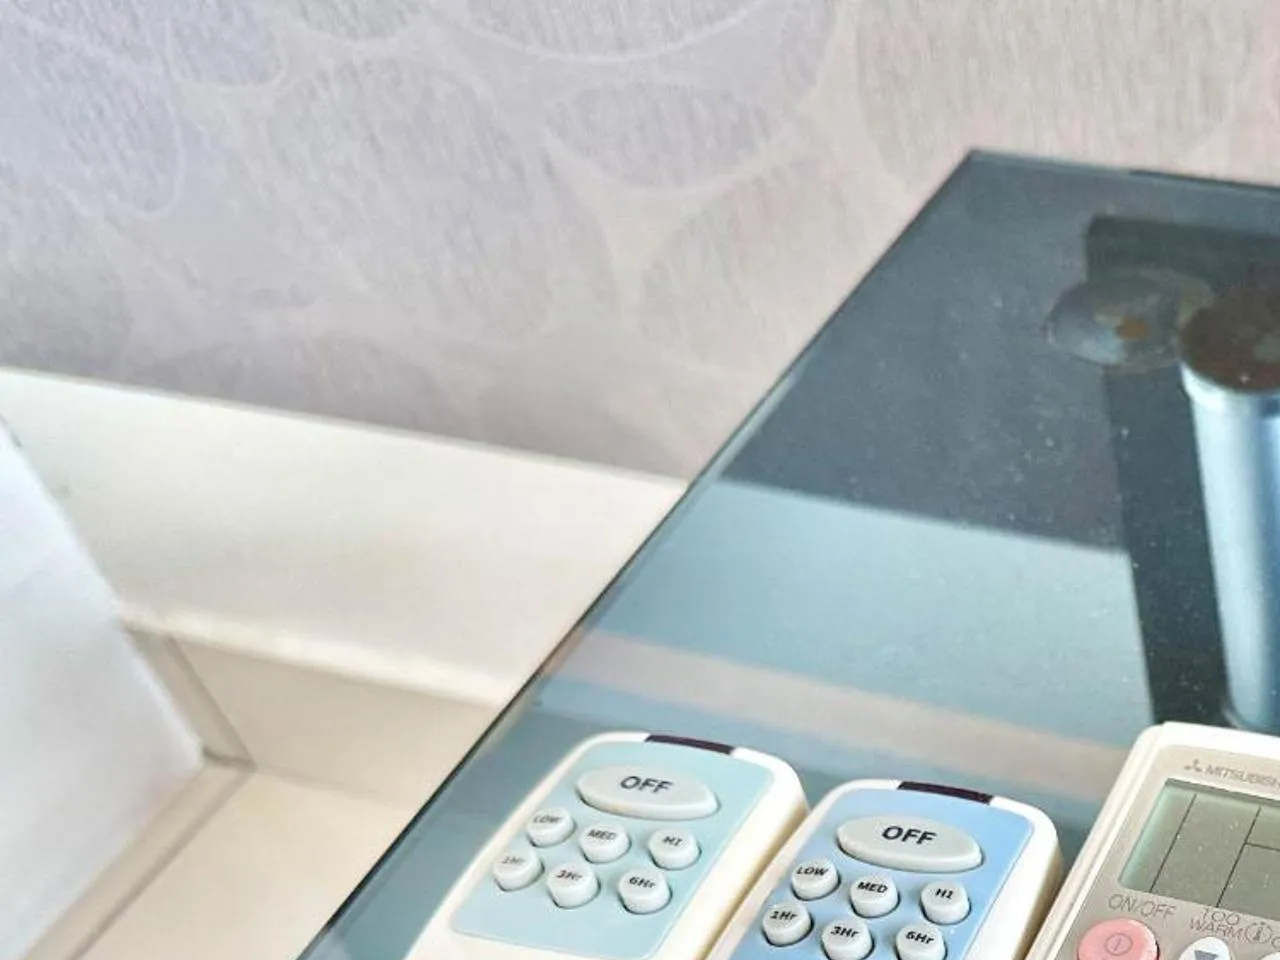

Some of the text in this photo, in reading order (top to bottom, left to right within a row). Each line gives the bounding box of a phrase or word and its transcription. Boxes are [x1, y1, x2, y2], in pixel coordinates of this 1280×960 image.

[619, 775, 673, 795] OFF
[587, 828, 617, 842] MED
[661, 835, 684, 848] HI
[881, 825, 938, 846] OFF
[796, 865, 830, 878] LOW
[856, 880, 889, 895] MED
[934, 887, 955, 900] HI
[1107, 893, 1177, 919] ON/OFF
[770, 910, 800, 922] 1Hr
[1202, 908, 1241, 926] TOO
[830, 925, 861, 940] 3Hr
[1189, 917, 1244, 939] WARM
[905, 930, 936, 946] 6Hr
